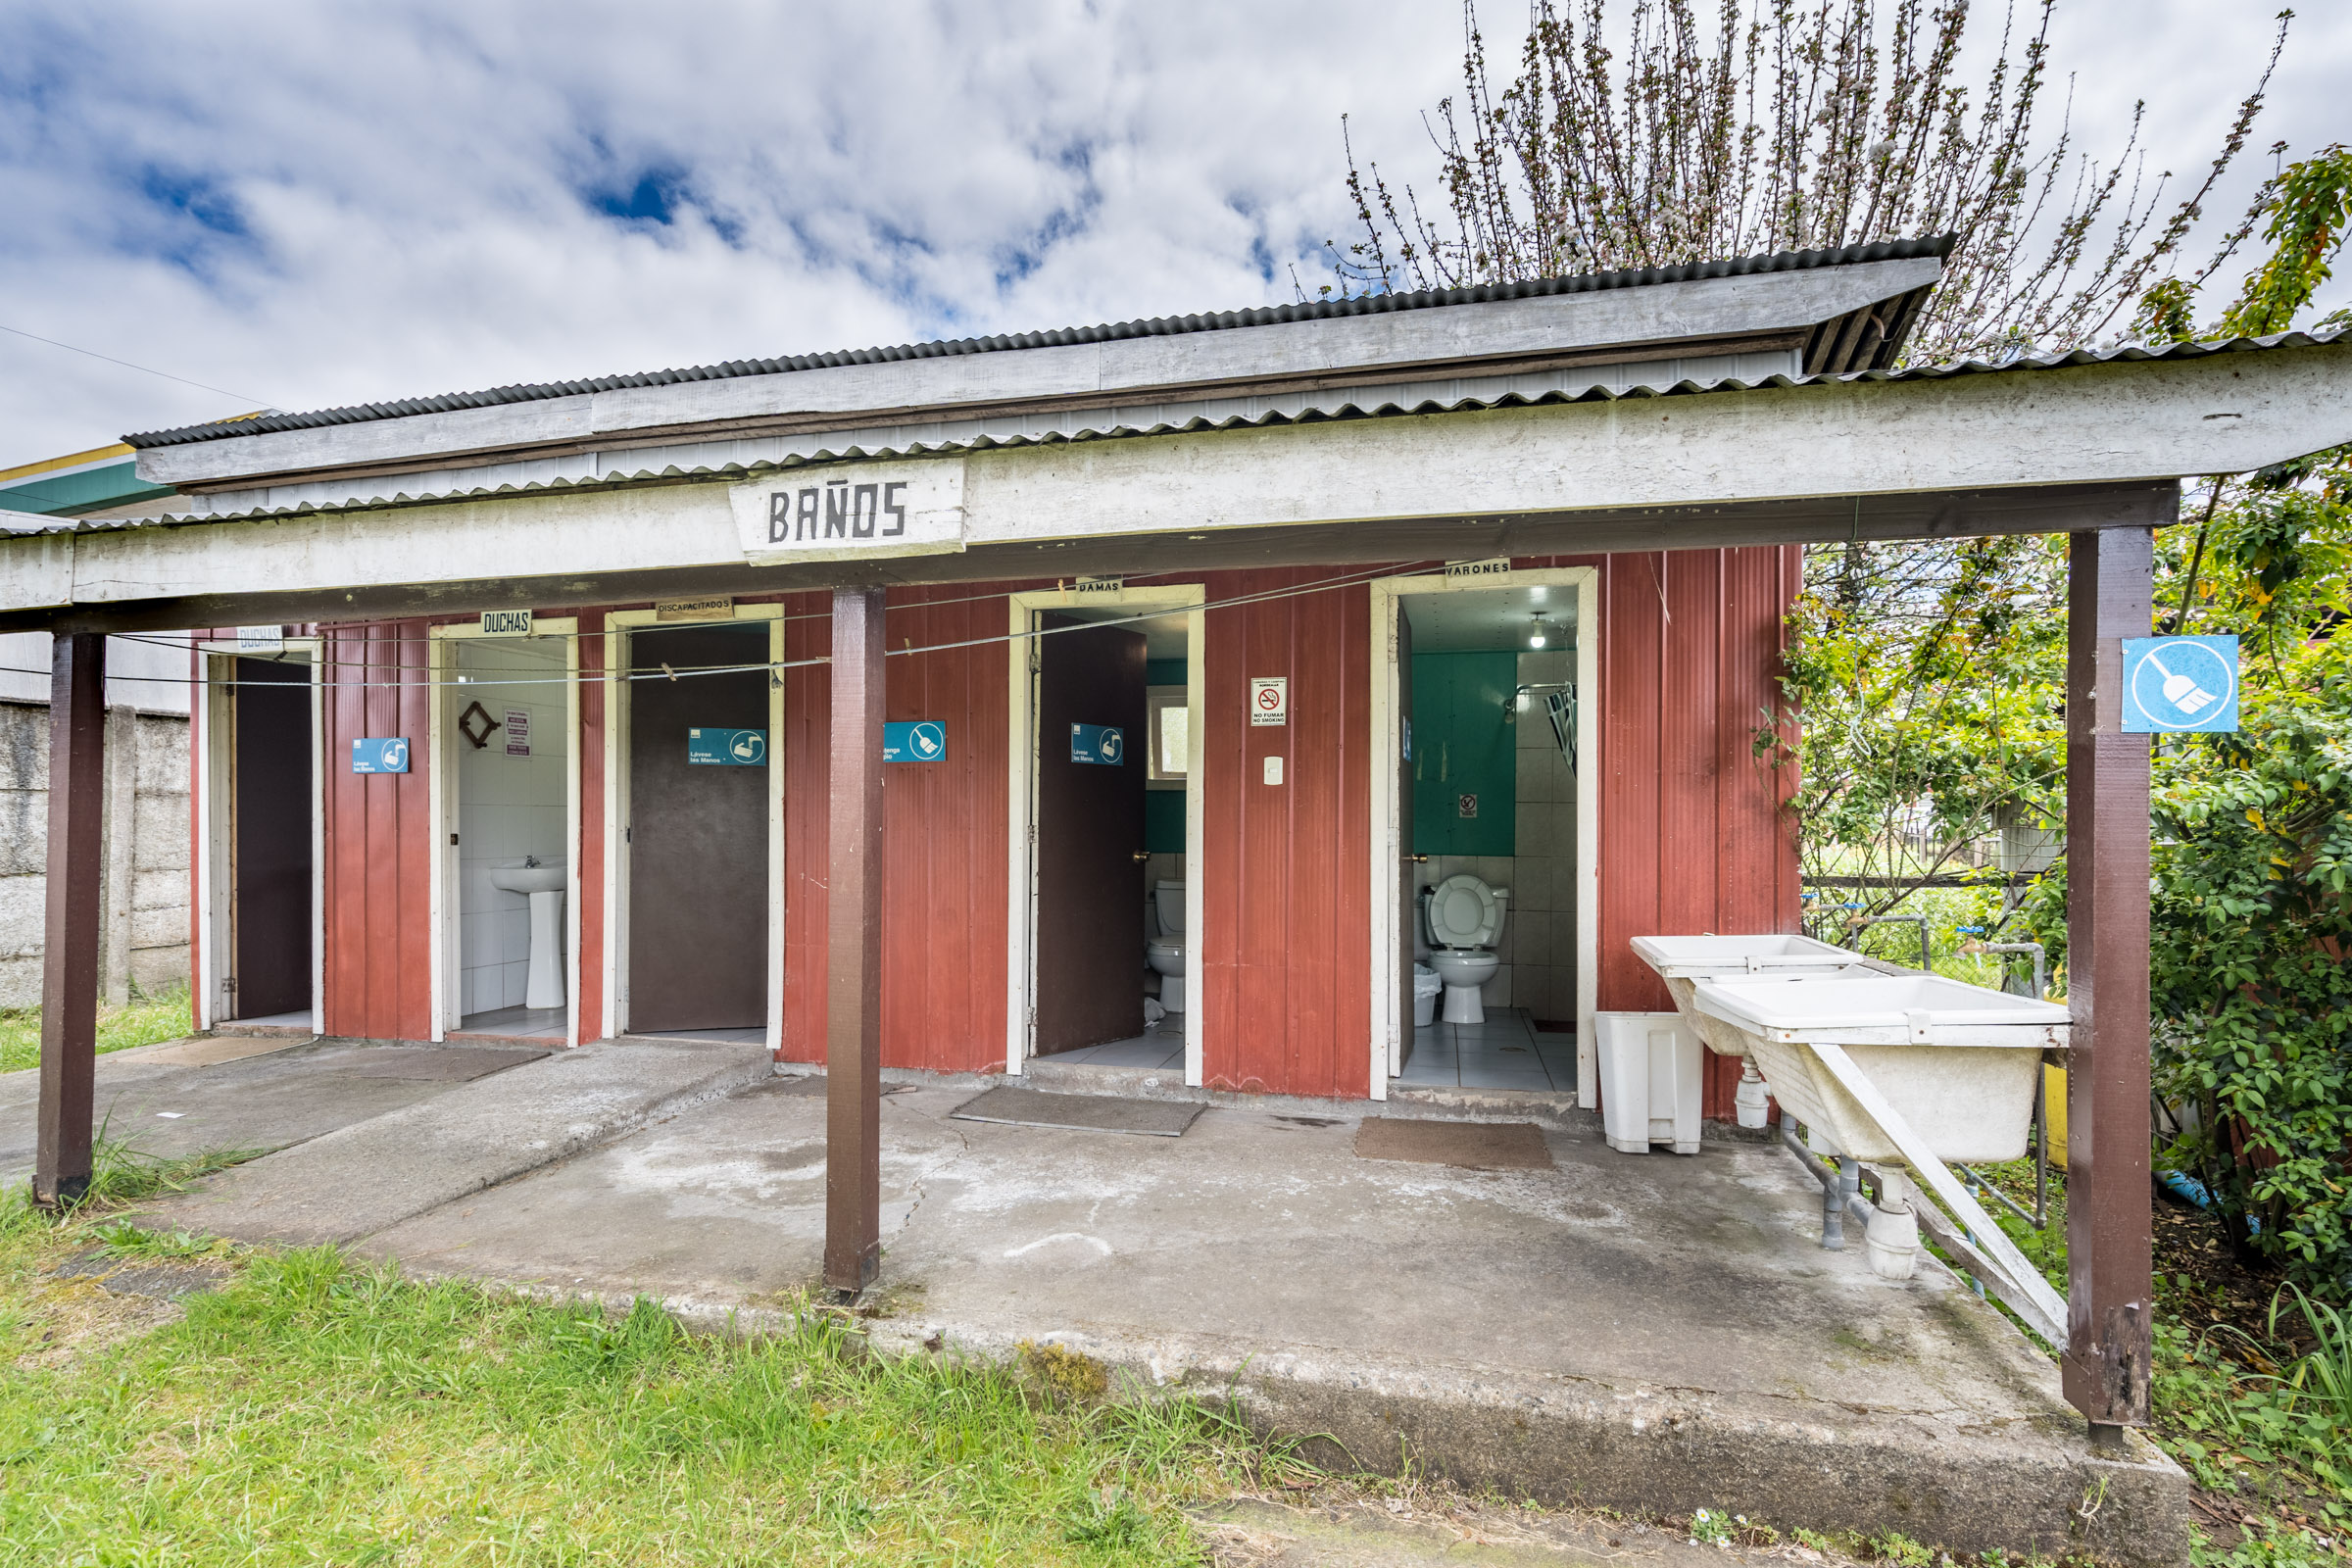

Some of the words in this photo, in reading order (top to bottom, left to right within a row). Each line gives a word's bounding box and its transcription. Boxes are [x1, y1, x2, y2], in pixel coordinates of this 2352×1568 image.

[768, 479, 907, 544] BAÑOS
[1446, 563, 1509, 575] VARONES
[1079, 582, 1119, 592] DAMAS
[658, 600, 730, 612] DISCAPACITADOS
[484, 612, 528, 632] DUCHAS
[239, 628, 280, 648] DUCHAS
